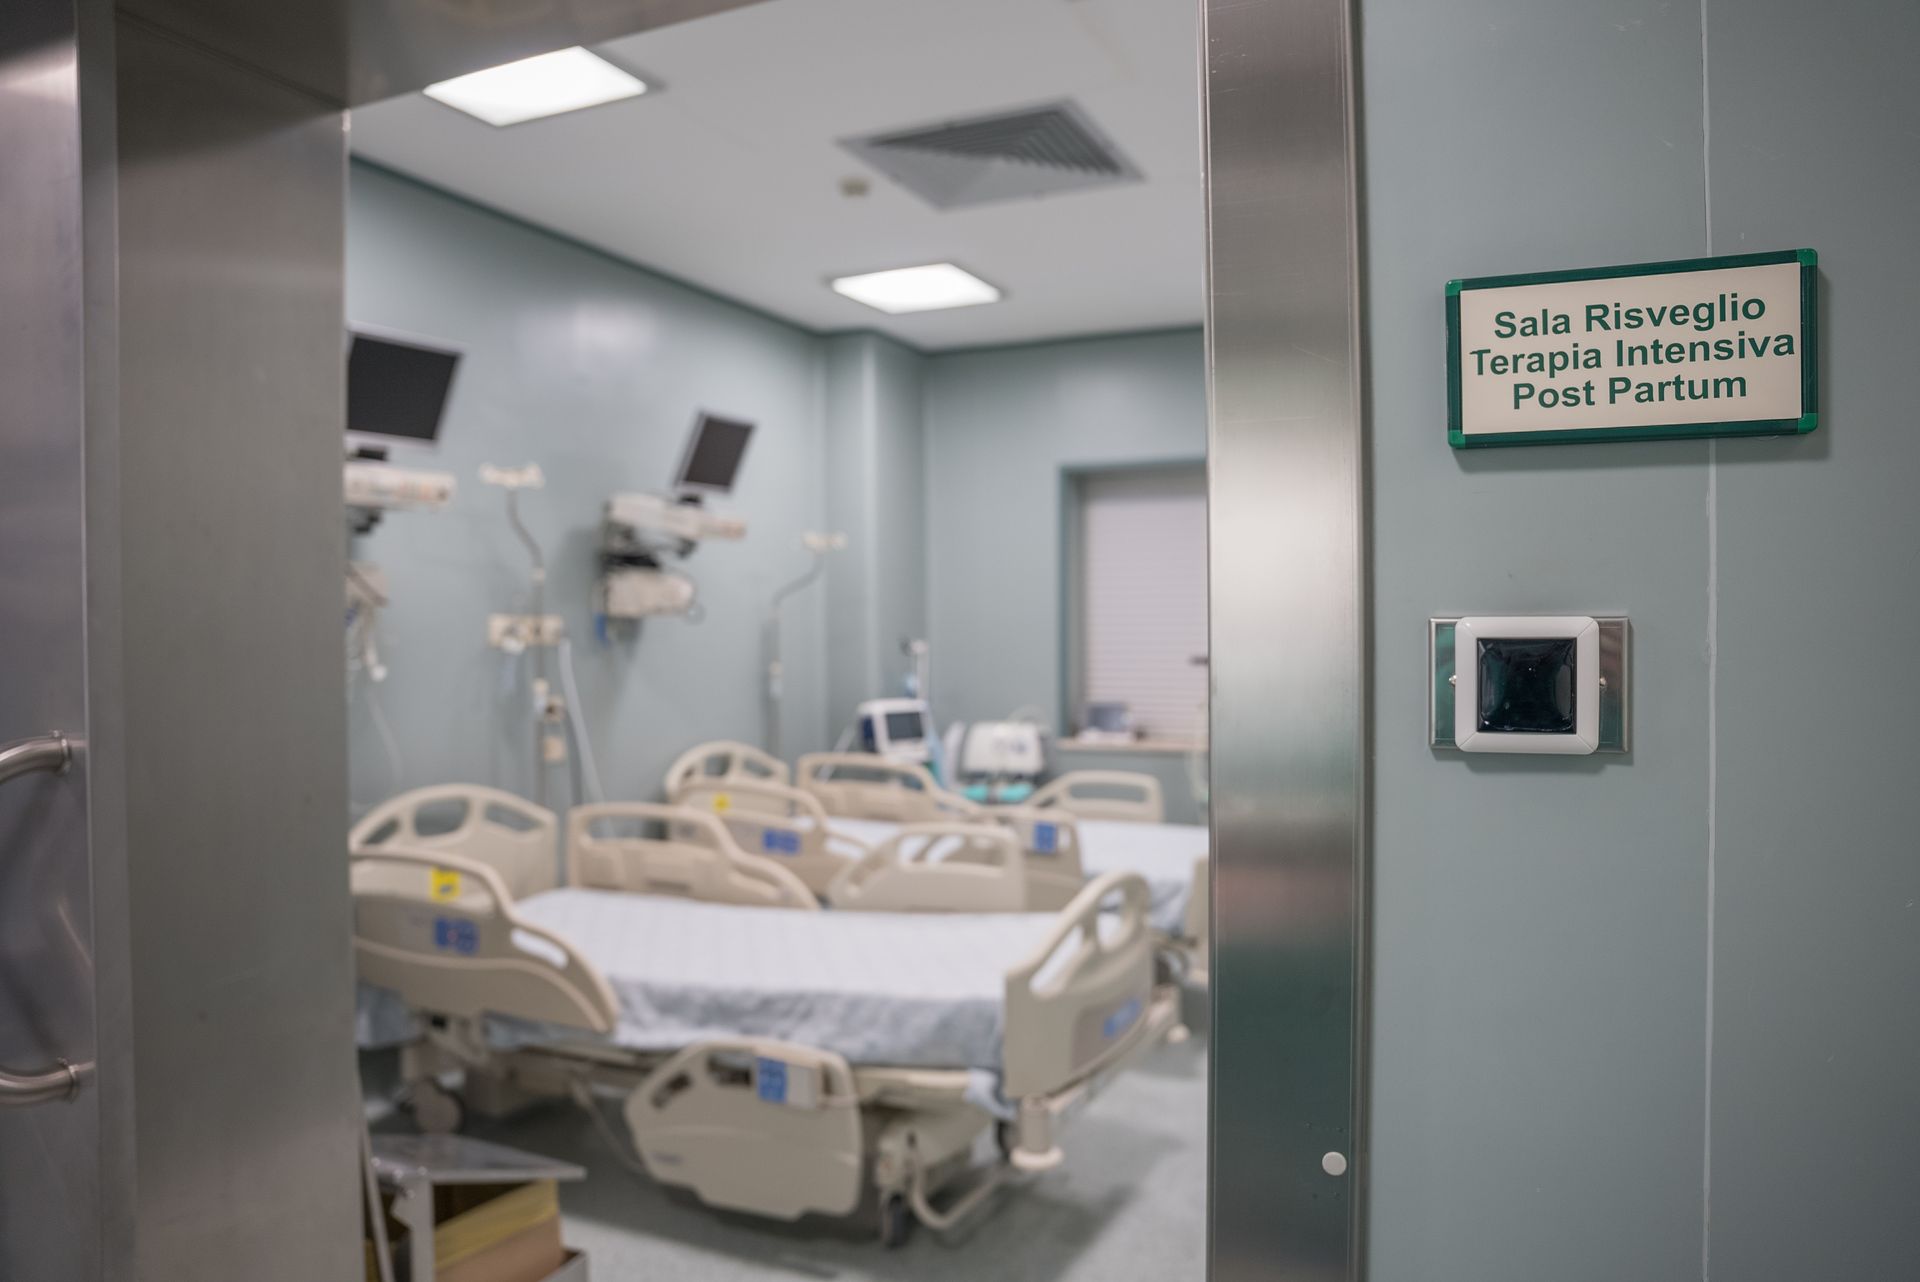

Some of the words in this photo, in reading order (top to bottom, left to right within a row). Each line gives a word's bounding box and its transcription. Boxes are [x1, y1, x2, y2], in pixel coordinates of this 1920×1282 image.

[1494, 308, 1571, 339] Sala
[1585, 293, 1766, 332] Risveglio
[1469, 342, 1602, 379] Terapia
[1616, 331, 1795, 368] Intensiva
[1513, 379, 1595, 410] Post
[1608, 373, 1747, 405] Partum
